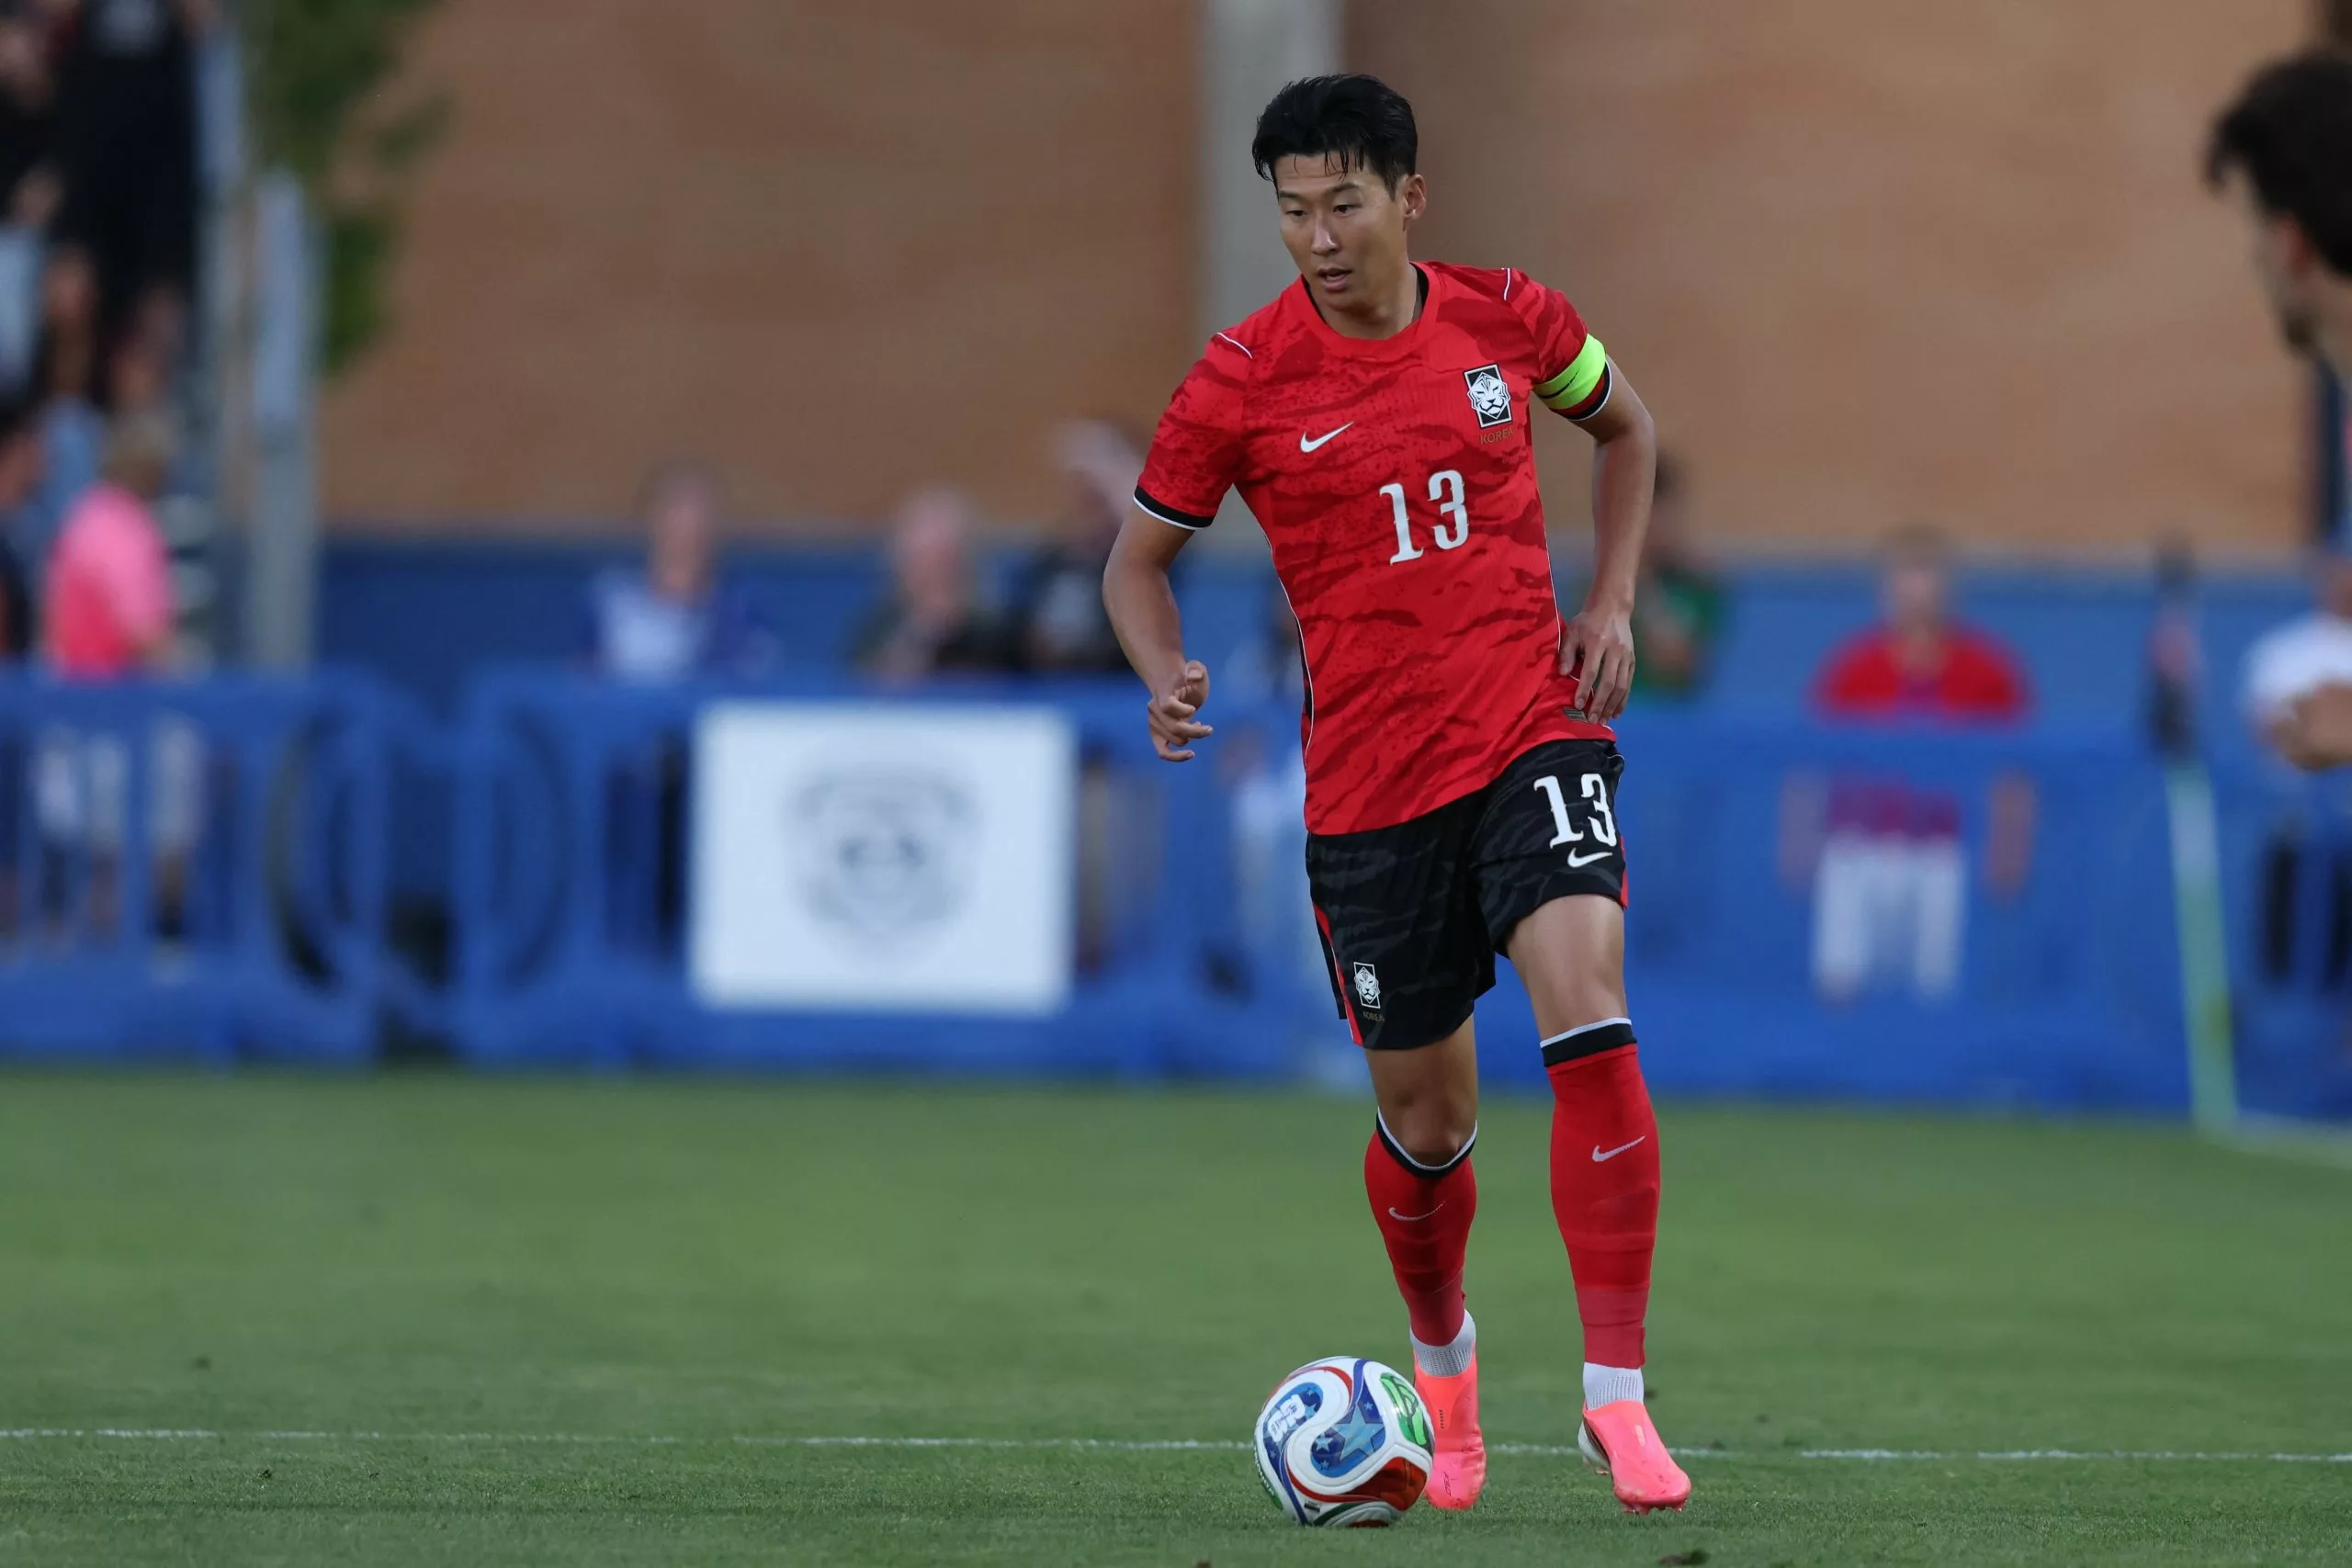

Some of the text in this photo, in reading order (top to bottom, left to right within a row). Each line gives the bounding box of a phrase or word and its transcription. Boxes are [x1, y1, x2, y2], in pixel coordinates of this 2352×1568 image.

[1480, 426, 1513, 445] KOREA
[1380, 469, 1468, 565] 13
[1533, 773, 1617, 849] 13
